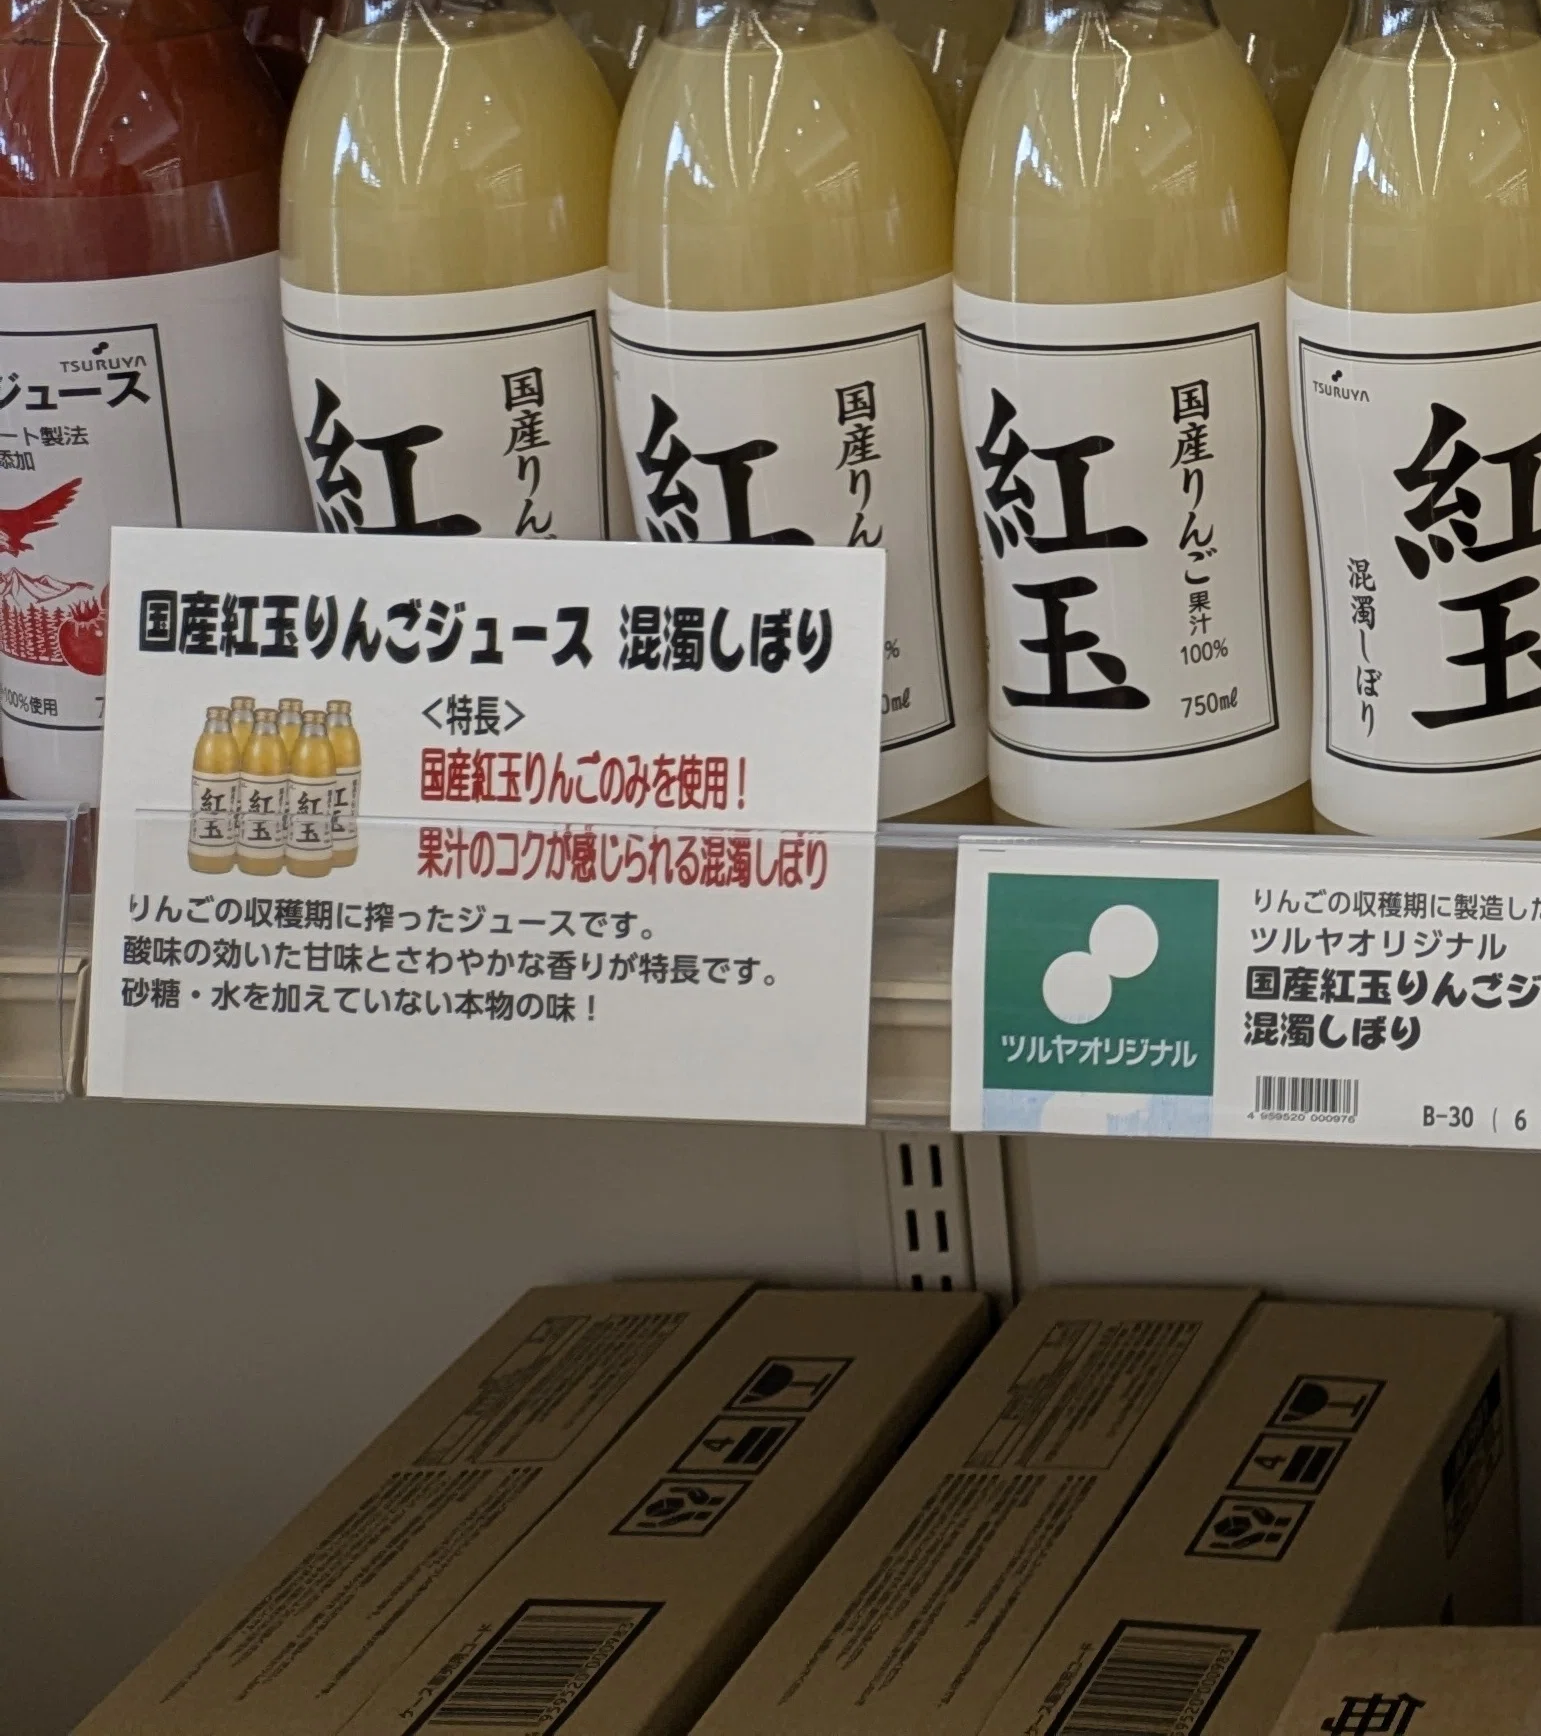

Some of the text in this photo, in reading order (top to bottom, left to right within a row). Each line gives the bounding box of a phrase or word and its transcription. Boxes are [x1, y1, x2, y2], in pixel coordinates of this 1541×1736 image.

[60, 355, 147, 372] TSURUYA
[1313, 380, 1370, 403] TSURUYA
[975, 387, 1150, 710] 紅玉
[139, 589, 832, 674] 国産紅玉りんごジュース 混濁しぼり
[1347, 556, 1382, 737] 混濁しぼり
[420, 748, 749, 810] 国産紅玉りんごのみを使用！
[417, 826, 828, 890] 果汁のコクが感じられる混濁しぼり
[129, 892, 653, 941] りんごの収穫期に搾ったジュースです。
[122, 936, 776, 987] 酸味の効いた甘味とさわやかな香りが特長です。
[1250, 927, 1507, 961] ツルヤオリジナル
[121, 977, 596, 1022] 砂糖・水を加えていない本物の味！
[1001, 1034, 1197, 1067] ツルヤオリジナル
[1244, 1012, 1421, 1051] 混濁しぼり
[1423, 1105, 1474, 1127] B-30
